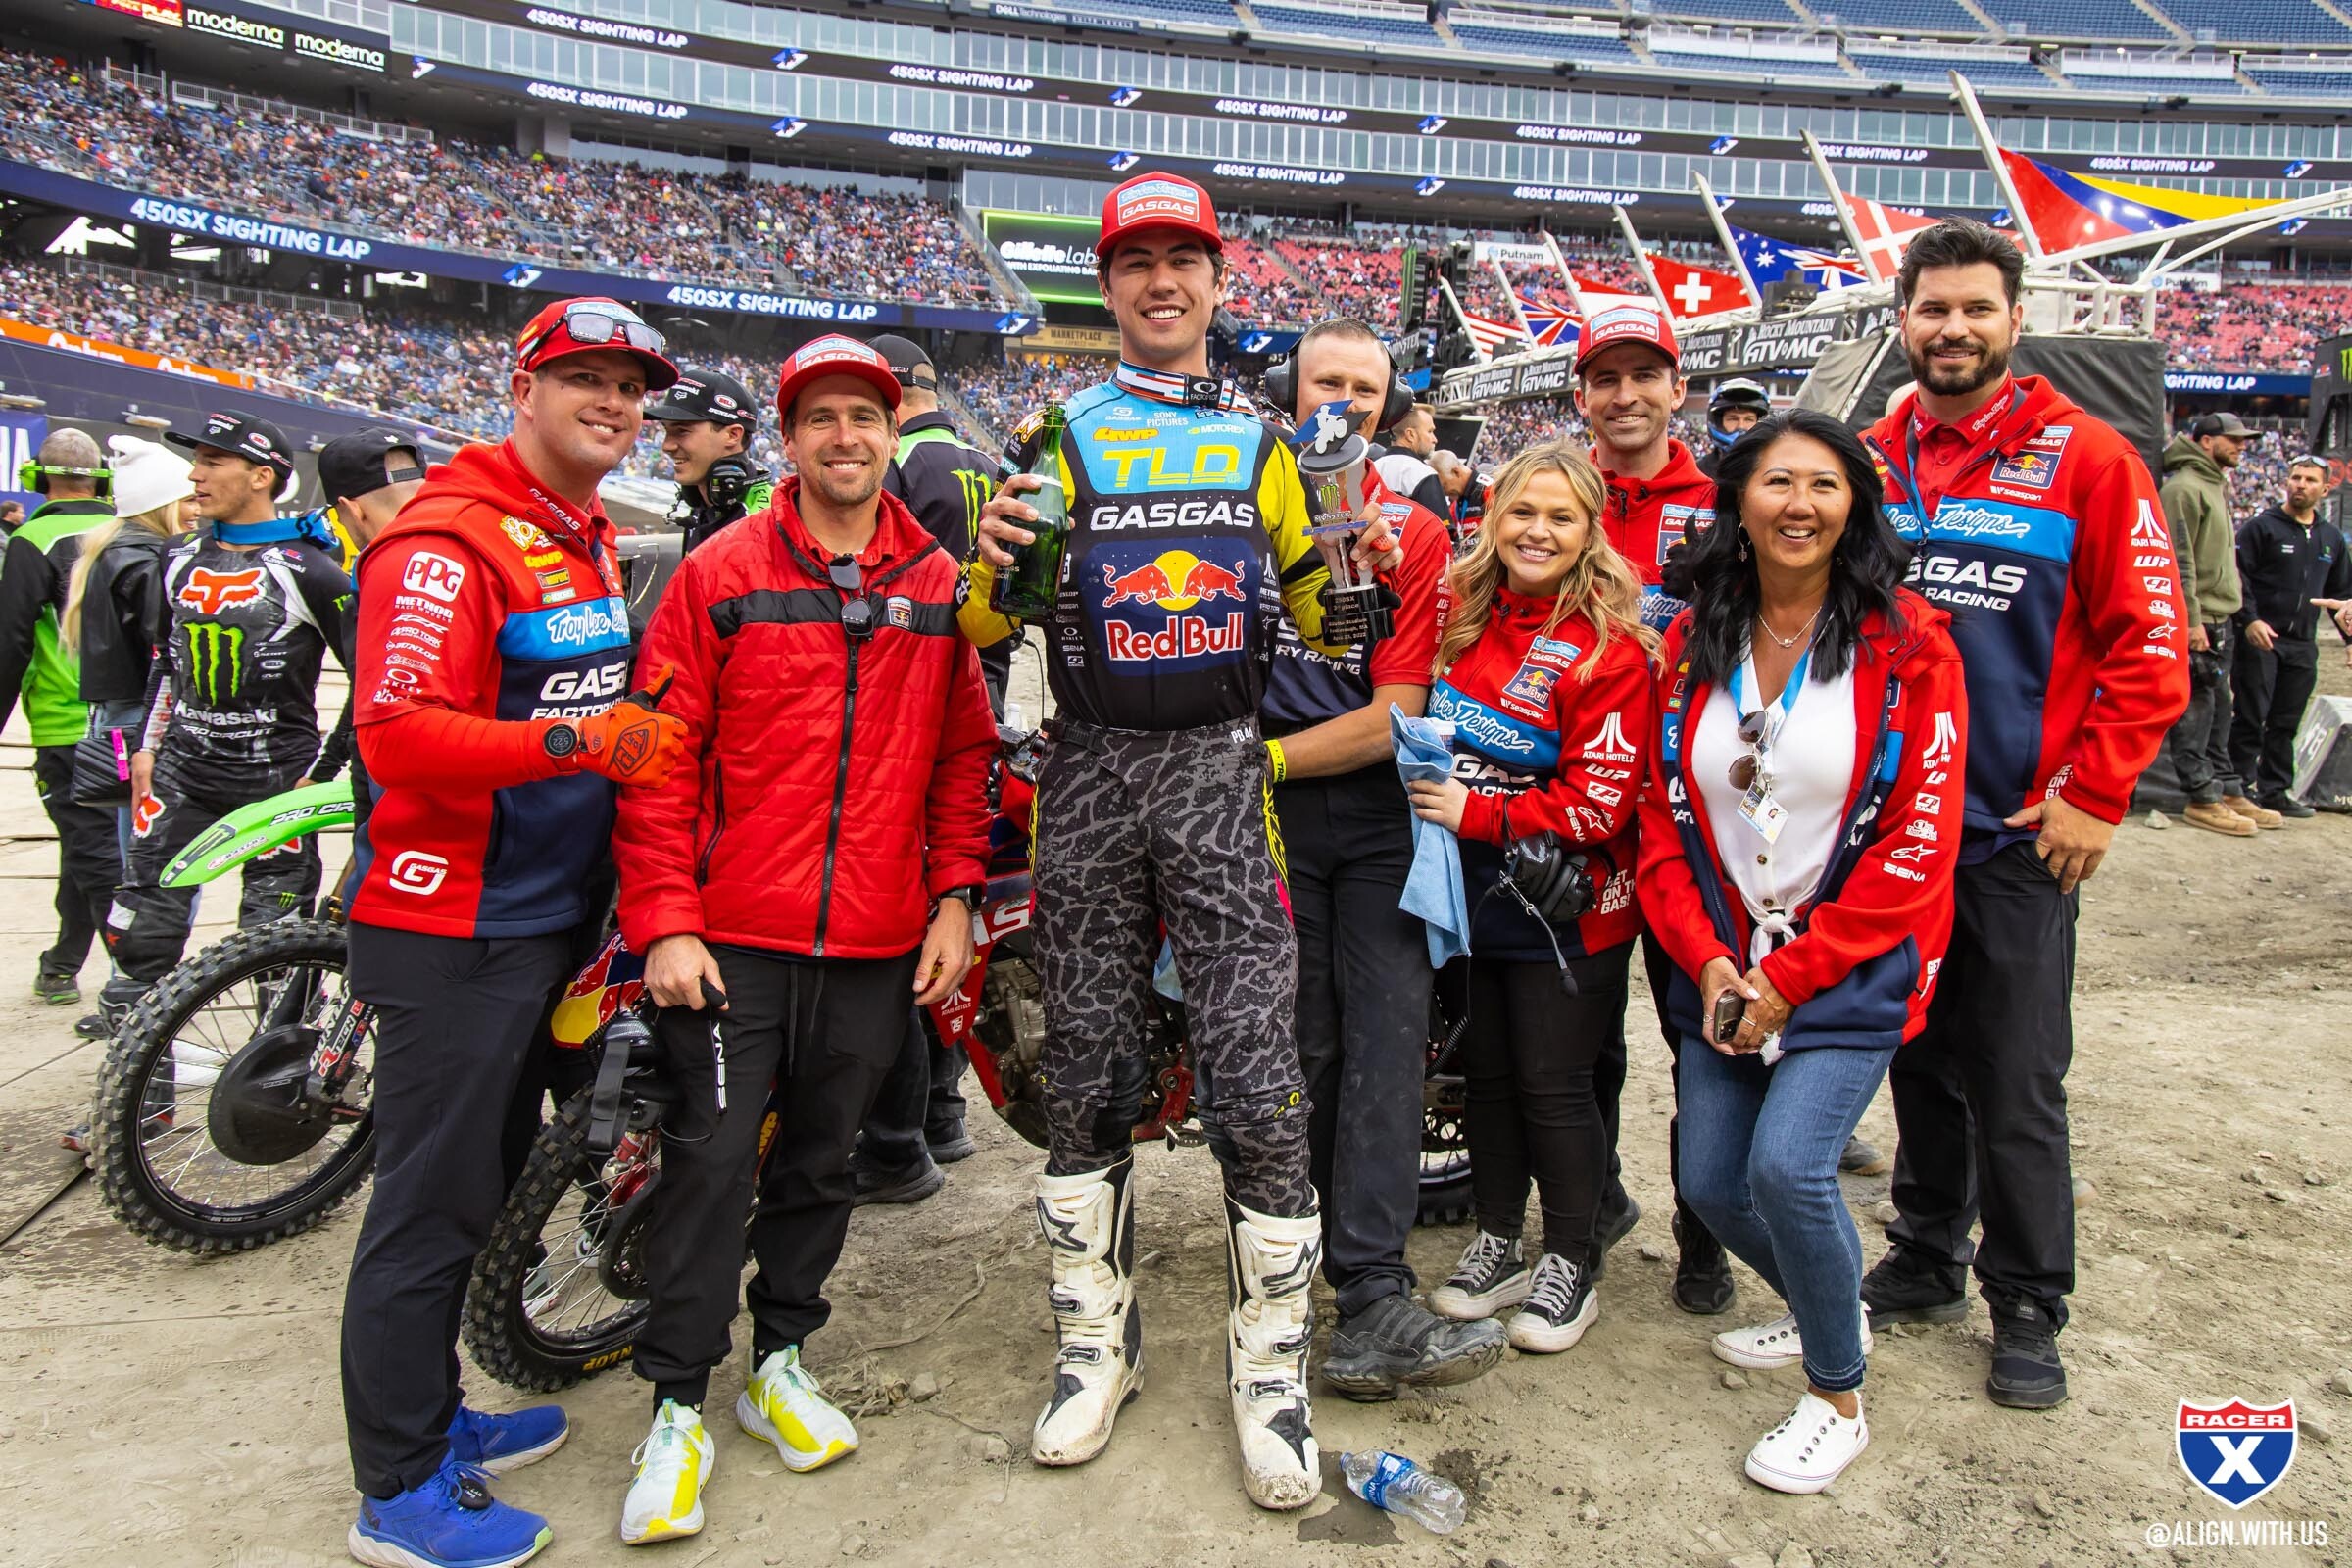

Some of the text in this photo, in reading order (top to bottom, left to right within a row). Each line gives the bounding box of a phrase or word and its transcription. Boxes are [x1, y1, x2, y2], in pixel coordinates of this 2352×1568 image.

[996, 4, 1019, 15] DELL
[187, 9, 284, 44] moderna
[526, 9, 688, 48] 450SX SIGHTING LAP
[296, 32, 385, 67] moderna
[889, 65, 1034, 91] 450SX SIGHTING LAP
[527, 82, 688, 119] 450SX SIGHTING LAP
[1215, 100, 1347, 122] 450SX SIGHTING LAP
[888, 132, 1032, 157] 450SX SIGHTING LAP
[1516, 125, 1642, 145] 450SX SIGHTING LAP
[1845, 146, 1928, 162] SIGHTING LAP
[1213, 164, 1345, 184] 450SX SIGHTING LAP
[2090, 157, 2215, 172] 450SX SIGHTING LAP
[1513, 186, 1639, 205] 450SX SIGHTING LAP
[1122, 201, 1195, 219] GASGAS
[130, 197, 371, 260] 450SX SIGHTING LAP
[1499, 248, 1544, 261] Putnam
[667, 286, 877, 321] 450SX SIGHTING LAP
[1595, 324, 1655, 340] GASGAS
[1757, 317, 1836, 340] ROCKY MOUNTAIN
[2226, 376, 2256, 390] LAP
[719, 397, 733, 406] BELL
[1147, 418, 1188, 427] PICTURES
[1201, 424, 1245, 434] MOTOREX
[1102, 444, 1241, 487] TLD
[2000, 467, 2046, 483] Red Bull
[2003, 487, 2042, 501] seaspan
[529, 488, 580, 531] GASGAS
[1090, 501, 1255, 531] GASGAS
[1313, 511, 1352, 522] MONSTER
[1931, 504, 2031, 536] Designs
[262, 554, 306, 573] Kawasaki
[2133, 555, 2171, 567] WP
[407, 557, 461, 593] PPG
[395, 596, 454, 618] METHOD
[1925, 588, 2011, 611] RACING
[547, 609, 586, 645] Troy
[584, 606, 611, 638] Lee
[1105, 612, 1244, 661] Red Bull
[395, 642, 440, 661] DUNLOP
[1531, 653, 1571, 668] GASGAS
[2143, 645, 2177, 659] SENA
[1511, 683, 1549, 704] Red Bull
[174, 700, 277, 726] Kawasaki
[1510, 704, 1544, 720] seaspan
[207, 727, 274, 739] CIRCUIT
[1453, 700, 1535, 750] Designs
[1231, 727, 1253, 744] PB 44
[1582, 751, 1635, 763] ATARI HOTELS
[1585, 763, 1631, 780] WP
[270, 806, 316, 826] PRO
[1565, 806, 1586, 842] SENA
[409, 863, 447, 874] GASGAS
[1883, 862, 1925, 883] SENA
[1603, 884, 1622, 901] ON
[1600, 894, 1630, 915] GAS!
[955, 1002, 971, 1013] HOTELS
[713, 1023, 727, 1109] SENA
